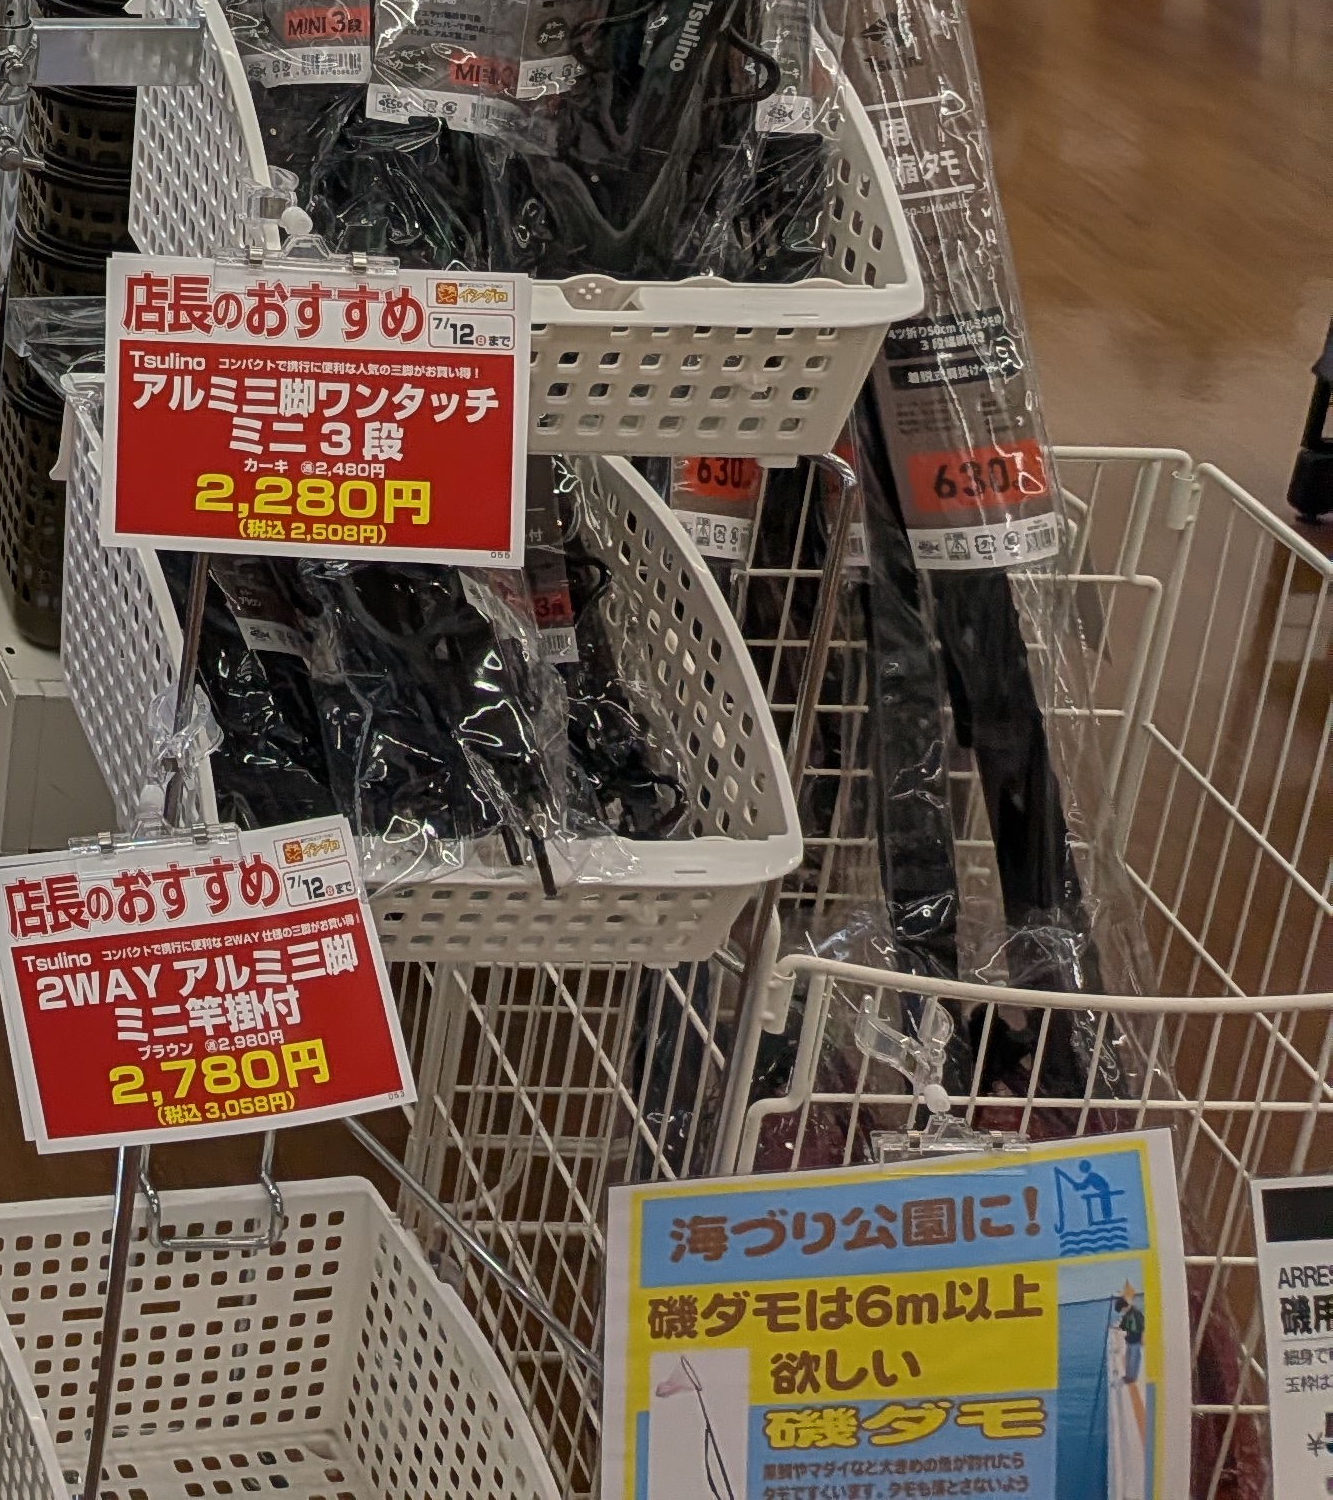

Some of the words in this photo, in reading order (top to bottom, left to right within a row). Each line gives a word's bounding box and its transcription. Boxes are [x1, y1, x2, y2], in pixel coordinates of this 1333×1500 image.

[288, 16, 327, 36] MINI
[331, 11, 363, 35] 3段
[669, 0, 713, 73] Tsulino
[122, 271, 426, 343] 店長のおすすめ
[459, 288, 509, 303] イシグロ
[129, 351, 206, 371] Tsulino
[132, 373, 499, 424] アルミ三脚ワンタッチ
[244, 459, 289, 475] カーキ
[195, 473, 431, 526] 2,280円
[290, 523, 388, 545] 2,508円)
[4, 853, 281, 940] 店長のおすすめ
[22, 951, 92, 973] Tsulino
[37, 964, 162, 1011] 2WAY
[173, 932, 359, 998] アルミ三脚
[115, 985, 301, 1043] ミニ竿掛付
[109, 1038, 330, 1107] 2,780円
[138, 1041, 193, 1061] ブラウン
[204, 1092, 296, 1120] 3,058円)
[669, 1188, 1042, 1263] 海づり公園に！
[647, 1272, 1044, 1341] 磯ダモは6m以上
[769, 1347, 921, 1396] 欲しい
[762, 1398, 1046, 1450] 磯ダモ
